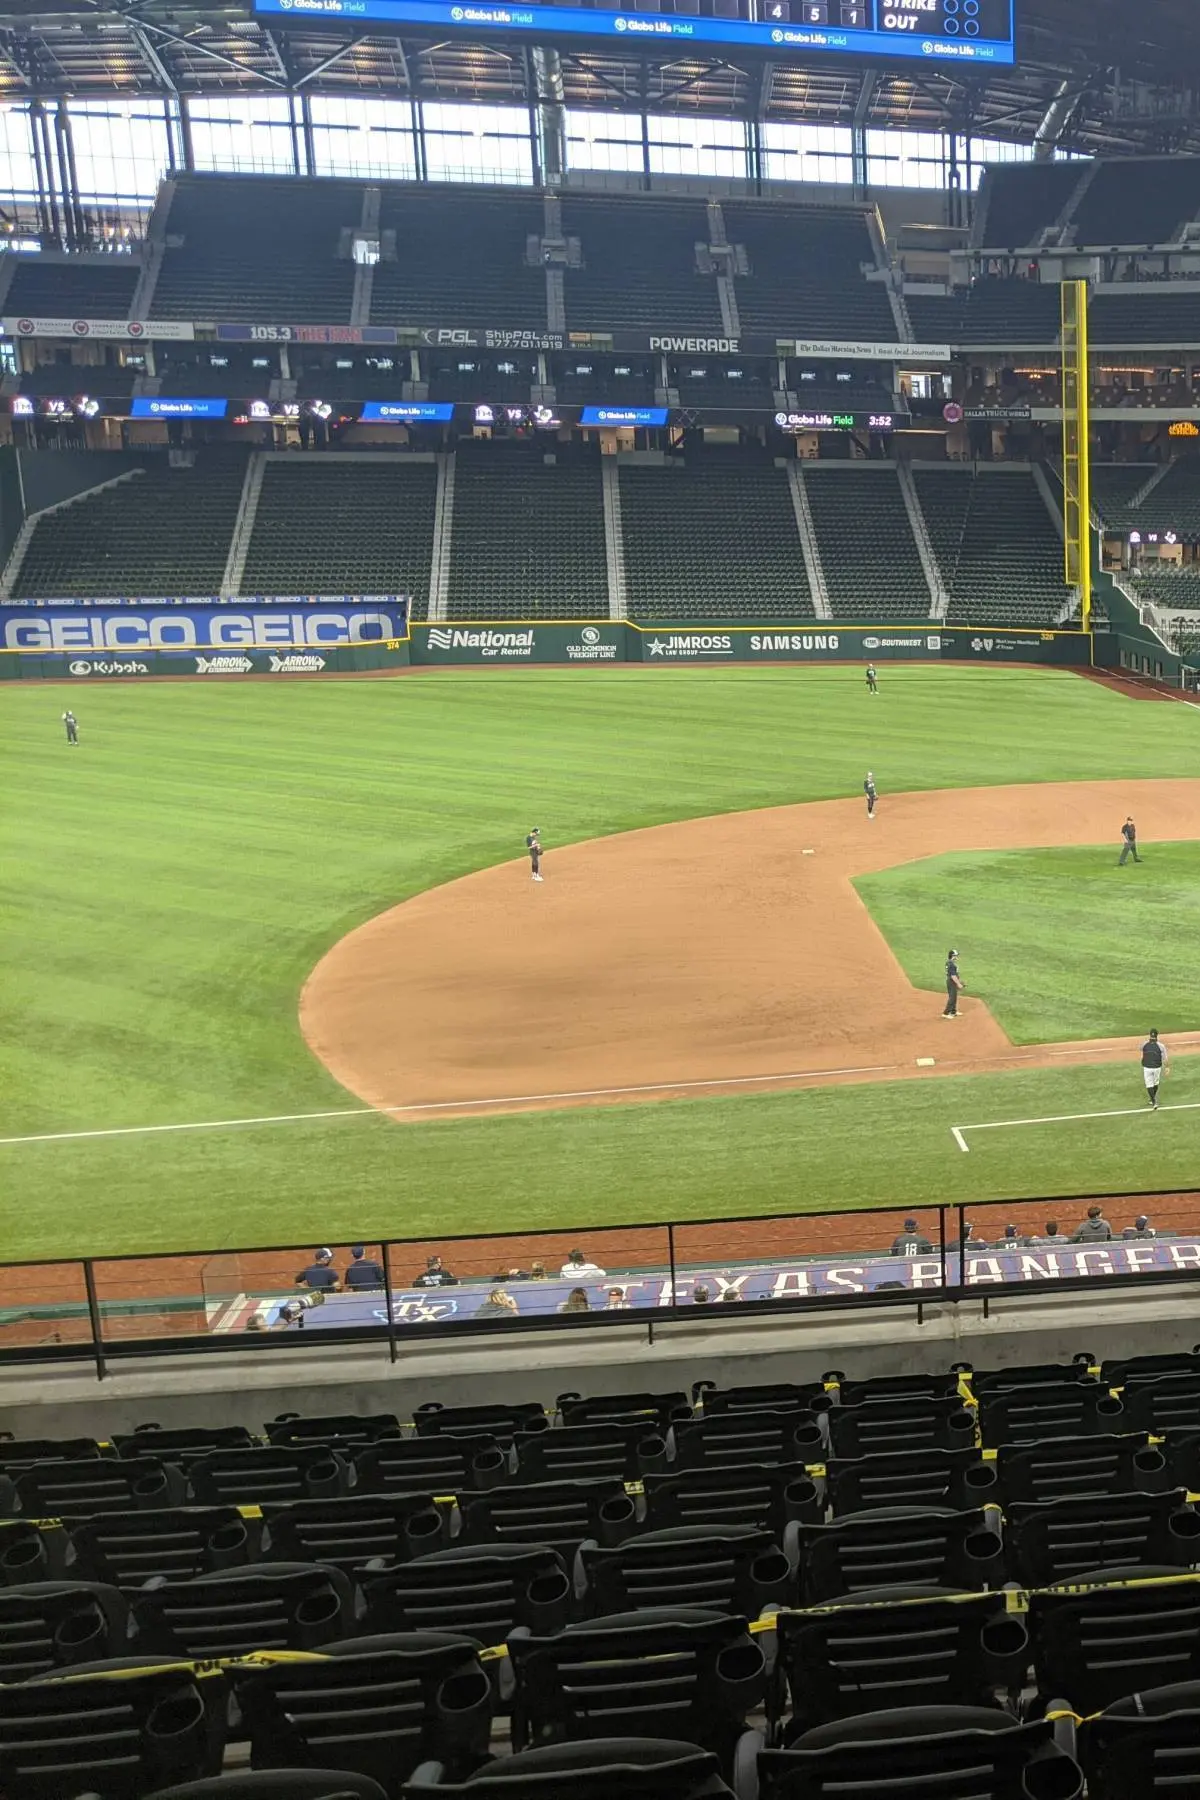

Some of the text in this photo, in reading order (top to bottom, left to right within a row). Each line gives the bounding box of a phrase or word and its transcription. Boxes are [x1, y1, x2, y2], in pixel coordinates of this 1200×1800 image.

[324, 0, 342, 11] Life
[883, 0, 937, 10] STRIKE
[465, 9, 533, 23] Globe Life Field
[772, 5, 857, 23] 4 5 1
[628, 21, 693, 34] Globe Life Field
[884, 15, 919, 29] OUT
[784, 31, 847, 46] Globe Life Field
[934, 43, 994, 57] Globe Life Field
[251, 326, 291, 340] 105.3
[438, 330, 477, 343] PGL
[485, 330, 563, 341] ShipPGL.com
[649, 336, 739, 353] POWERADE
[813, 344, 831, 352] Dallas
[49, 401, 65, 412] VS
[284, 404, 300, 415] VS
[508, 409, 522, 419] VS
[788, 414, 854, 426] Globe Life Field
[869, 415, 892, 426] 3:52
[5, 613, 394, 653] GEICO GEICO
[751, 635, 839, 651] SAMSUNG
[881, 638, 922, 647] SOUTHWEST
[482, 647, 531, 656] Car Rental
[569, 651, 599, 659] FREIGHT
[210, 656, 243, 667] ARROW
[284, 655, 316, 666] ARROW
[94, 660, 149, 675] Kubota
[905, 1243, 918, 1256] 18
[602, 1268, 863, 1309] TEXAS
